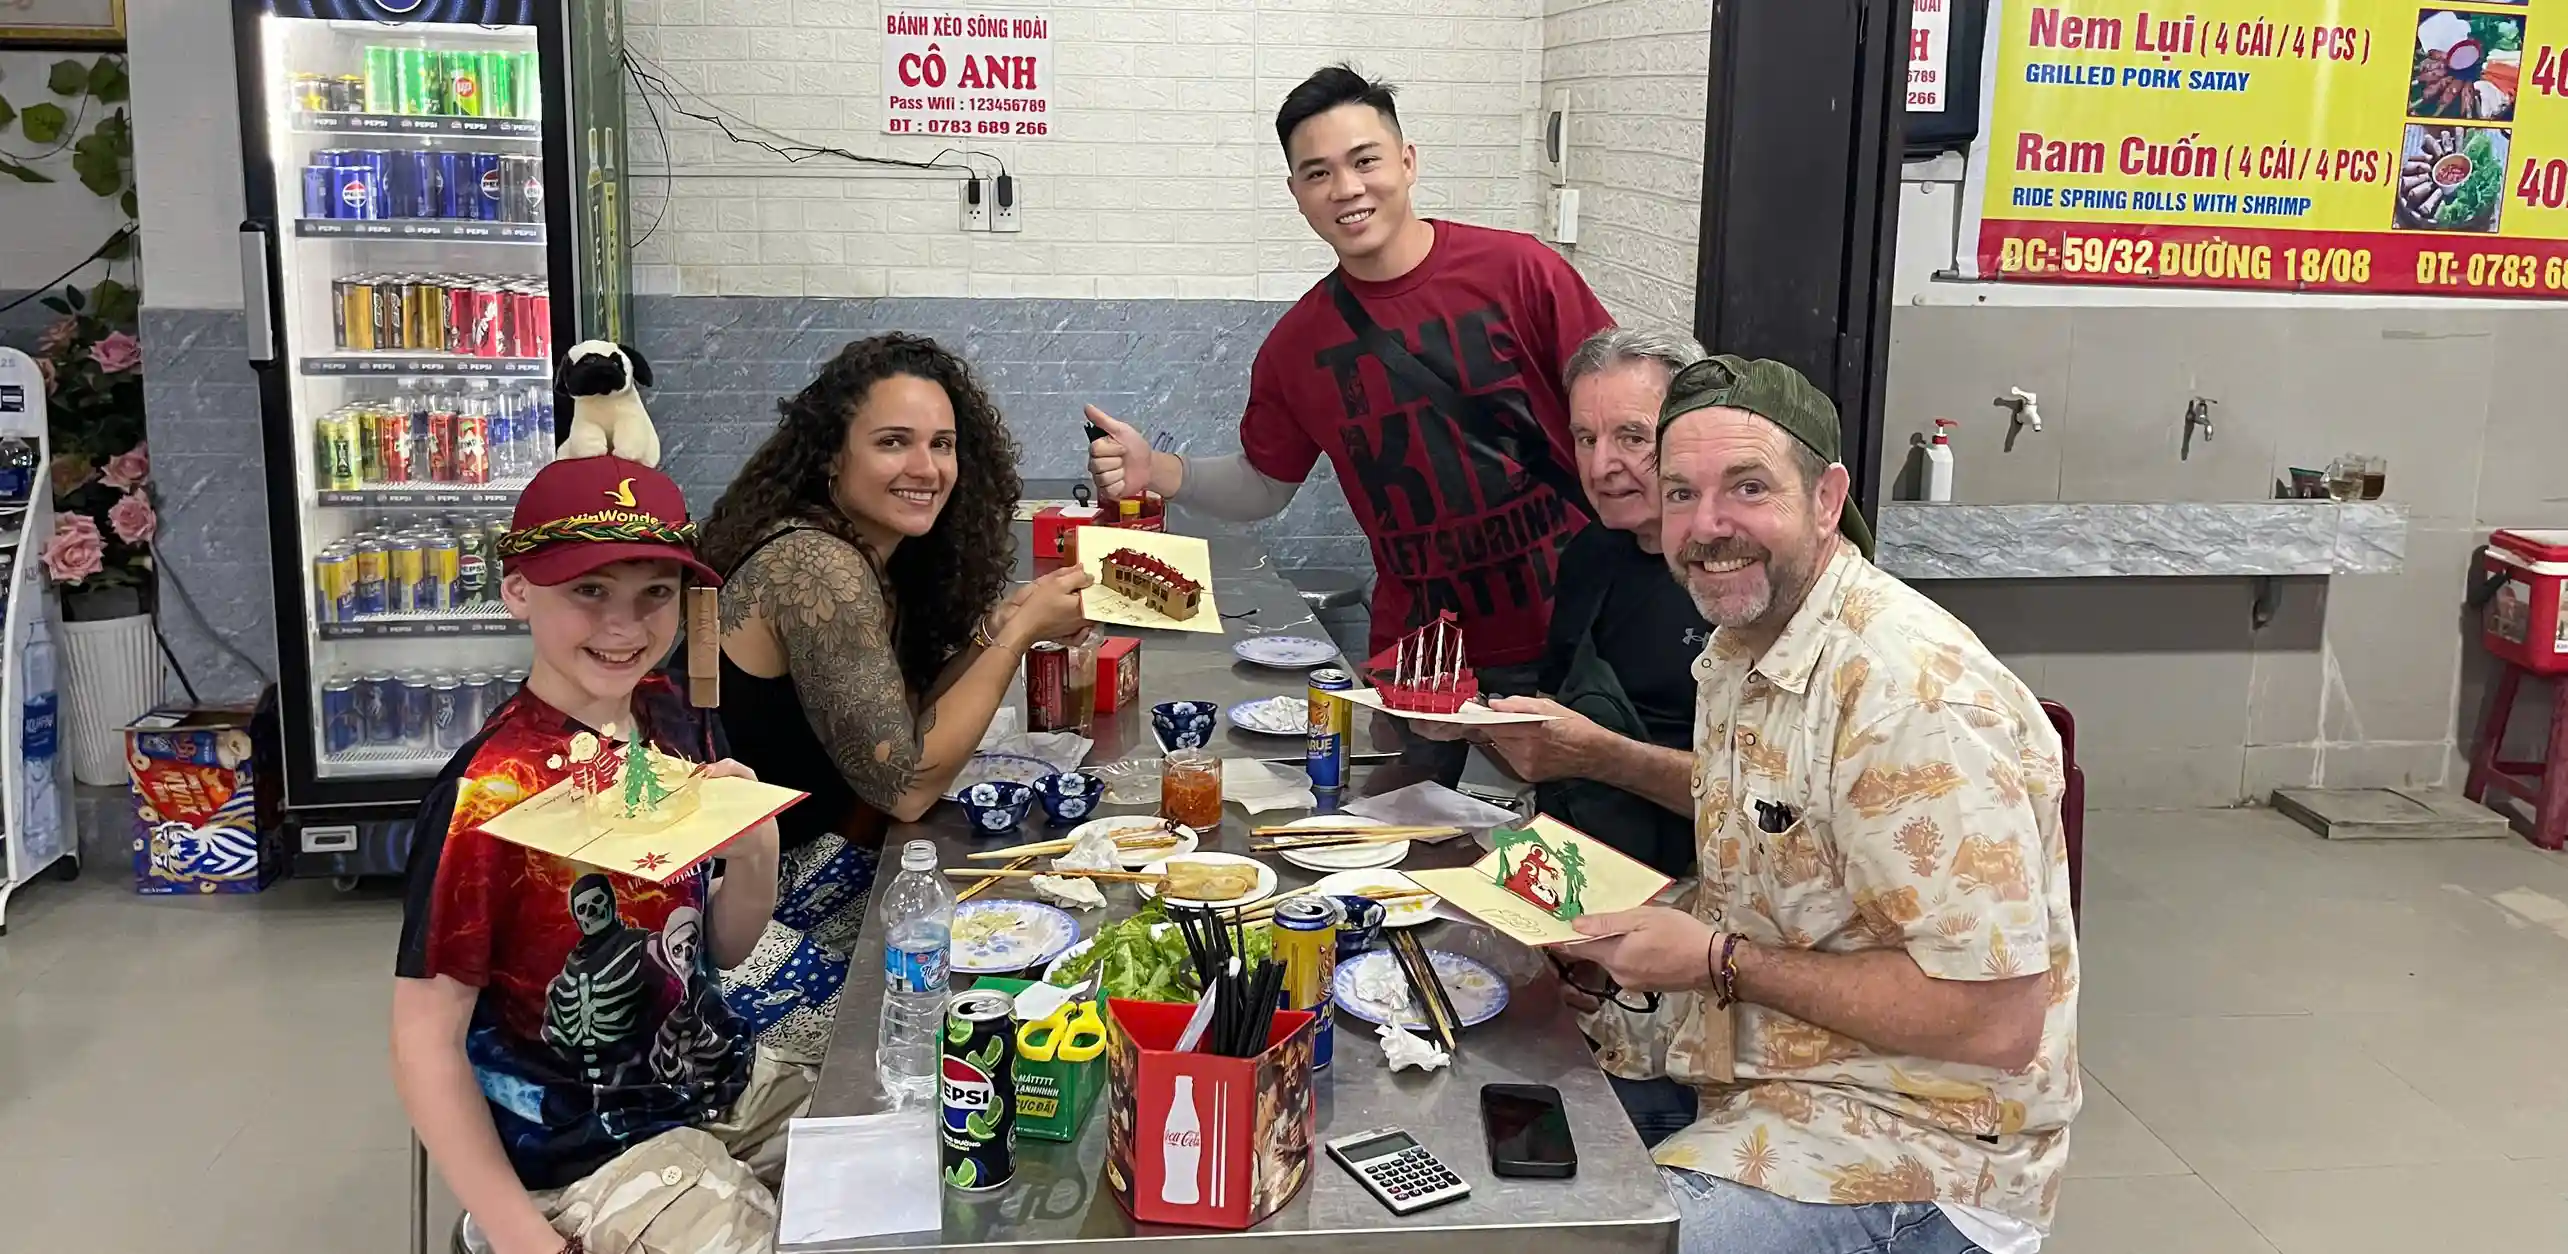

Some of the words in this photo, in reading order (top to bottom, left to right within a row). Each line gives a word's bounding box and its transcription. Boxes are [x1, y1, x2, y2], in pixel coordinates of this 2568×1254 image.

[887, 11, 928, 36] BÁNH
[933, 13, 962, 37] XÈO
[967, 14, 1008, 38] SÔNG
[1013, 16, 1047, 39] HOÀI
[2029, 8, 2122, 49] Nem
[2136, 12, 2195, 61] Lụi
[2215, 22, 2228, 55] 4
[2236, 16, 2273, 57] CÁI
[2293, 26, 2304, 58] 4
[2311, 26, 2356, 61] PCS
[899, 43, 946, 88] CÔ
[957, 54, 1037, 90] ANH
[2025, 63, 2116, 86] GRILLED
[2122, 68, 2182, 89] PORK
[2188, 71, 2251, 92] SATAY
[889, 96, 923, 110] Pass
[928, 96, 955, 111] Wifi
[969, 98, 1046, 112] 123456789
[1908, 92, 1936, 104] 266
[313, 117, 337, 126] PEPSI
[414, 121, 438, 129] PEPSI
[465, 122, 487, 130] PEPSI
[513, 123, 536, 132] PEPSI
[889, 119, 912, 132] ĐT
[928, 120, 972, 134] 0783
[977, 121, 1010, 134] 689
[1015, 121, 1047, 135] 266
[2016, 132, 2105, 174] Ram
[2120, 133, 2217, 177] Cuốn
[2239, 149, 2251, 178] 4
[2260, 140, 2295, 180] CÁI
[2316, 152, 2328, 188] 4
[2335, 149, 2379, 189] PCS
[2517, 158, 2568, 208] 40
[2013, 187, 2054, 208] RIDE
[2060, 189, 2127, 210] SPRING
[2132, 191, 2186, 212] ROLLS
[2193, 194, 2238, 214] WITH
[2243, 195, 2312, 216] SHRIMP
[418, 226, 440, 234] PEPSI
[466, 228, 488, 236] PEPSI
[514, 229, 537, 237] PEPSI
[2002, 237, 2057, 272] ĐC:
[2062, 237, 2154, 274] 59/32
[2158, 236, 2271, 280] ĐƯỜNG
[2284, 248, 2371, 282] 18/08
[2417, 250, 2458, 285] ĐT:
[2467, 253, 2536, 289] 0783
[944, 1082, 989, 1105] EPSI
